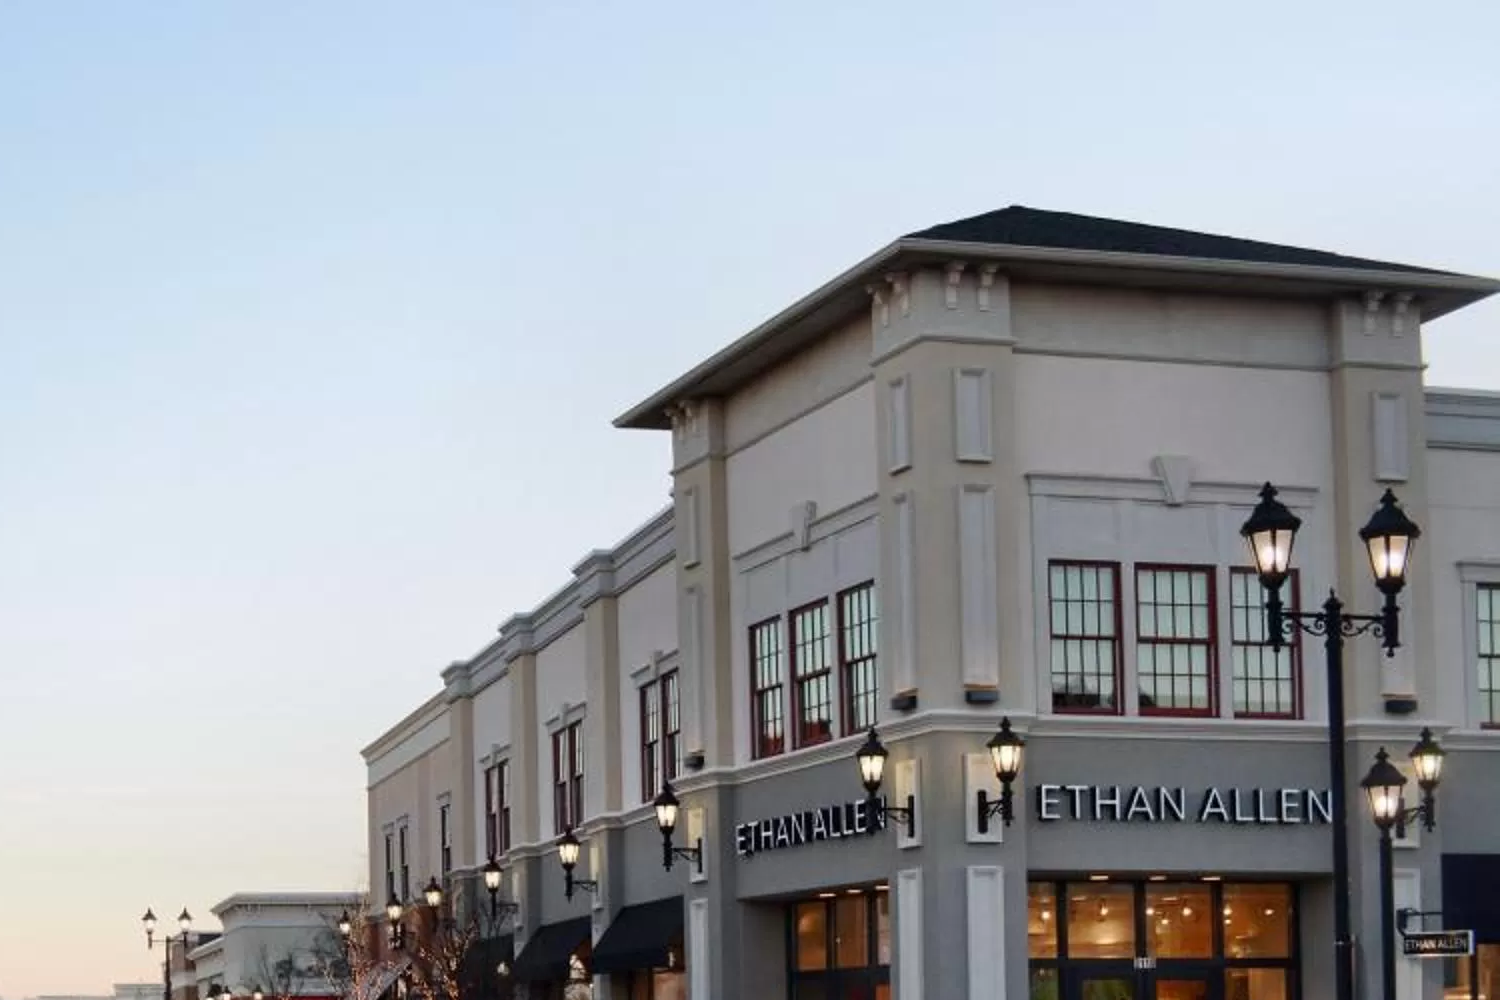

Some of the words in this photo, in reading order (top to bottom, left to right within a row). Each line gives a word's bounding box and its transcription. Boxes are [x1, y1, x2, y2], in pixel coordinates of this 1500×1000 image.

[1039, 784, 1185, 821] ETHAN
[1201, 787, 1333, 824] ALLEN
[735, 812, 805, 855] ETHAN
[1405, 938, 1436, 950] ETHAN
[1438, 936, 1467, 949] ALLEN
